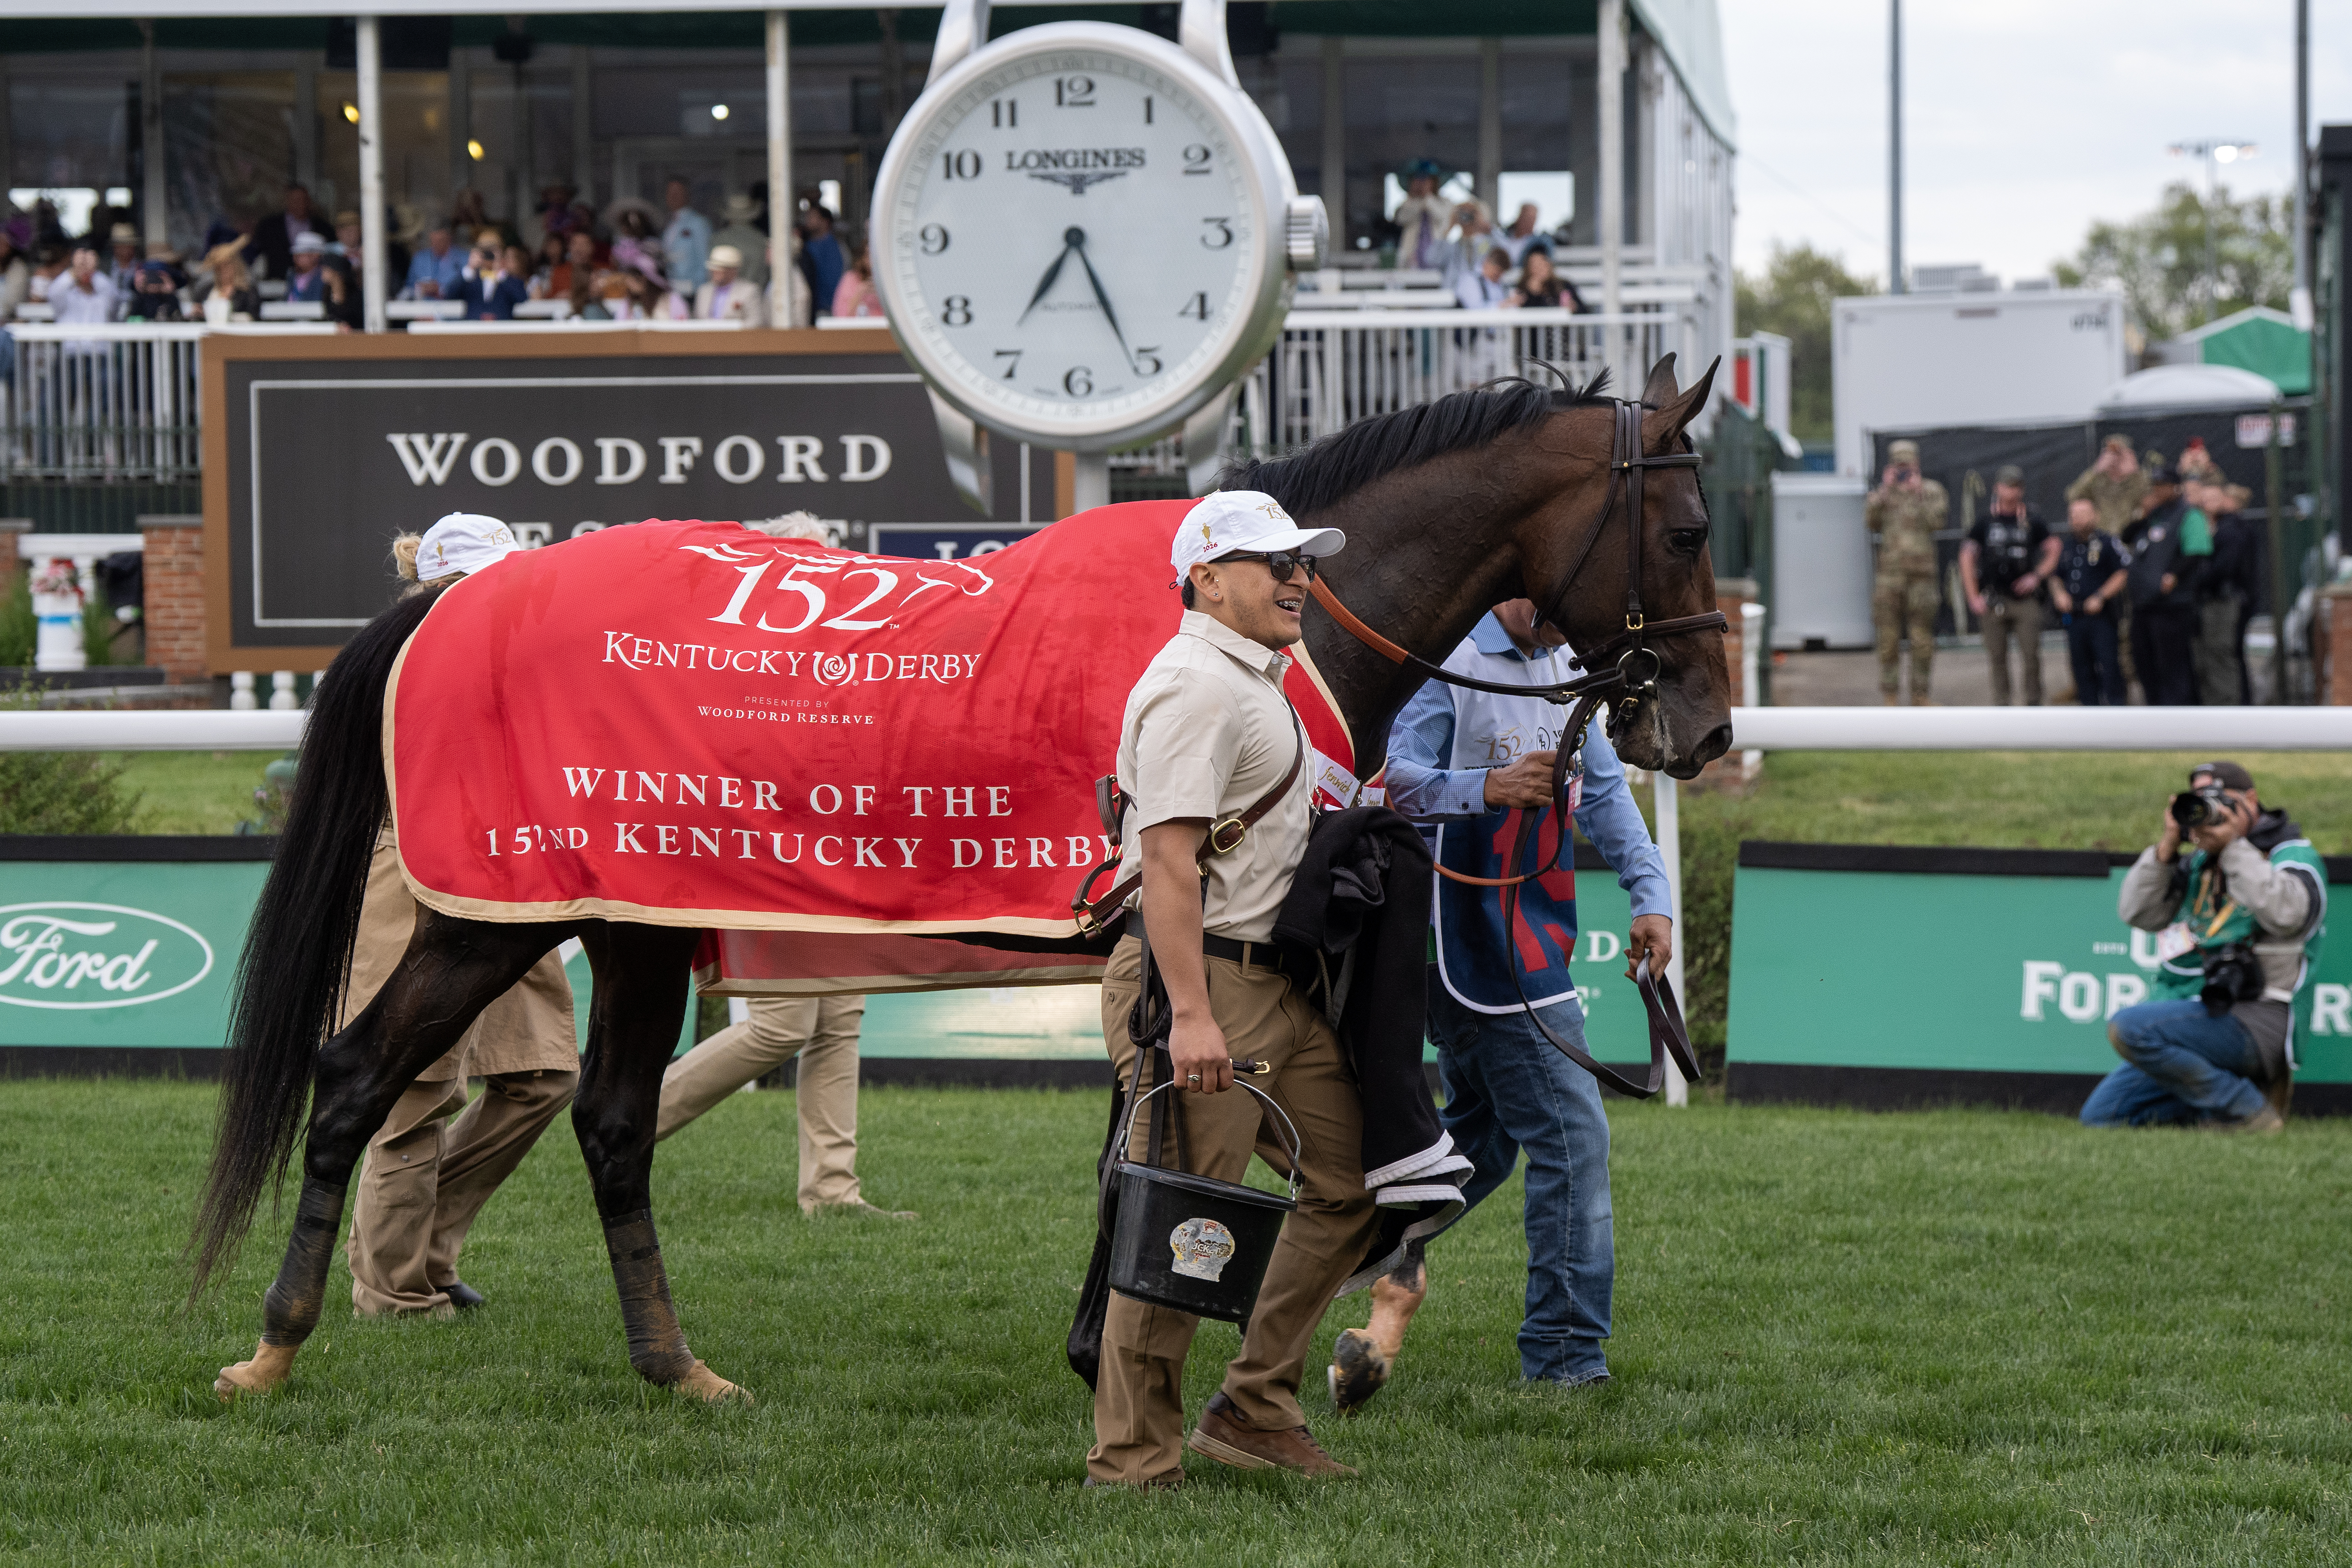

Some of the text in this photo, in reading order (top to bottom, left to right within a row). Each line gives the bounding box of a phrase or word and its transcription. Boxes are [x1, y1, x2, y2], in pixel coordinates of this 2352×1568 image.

[1054, 77, 1096, 108] 12
[990, 98, 1018, 129] 11
[1143, 95, 1155, 125] 1
[943, 150, 982, 181] 10
[1006, 148, 1147, 171] LONGINES
[1181, 144, 1212, 176] 2
[919, 222, 950, 256] 9
[1200, 217, 1234, 250] 3
[940, 295, 975, 327] 8
[1178, 291, 1214, 323] 4
[993, 348, 1023, 380] 7
[1134, 346, 1164, 377] 5
[1063, 366, 1094, 398] 6
[386, 433, 892, 486] WOODFORD
[1203, 542, 1218, 552] 2026
[707, 559, 893, 634] 152
[602, 630, 982, 685] KENTUCKY DERBY
[697, 705, 874, 725] WOODFORD RESERVE
[744, 696, 830, 708] PRESENTED BY
[1485, 735, 1522, 761] 152
[562, 766, 1013, 818] WINNER OF THE
[613, 822, 923, 868] KENTUCKY
[0, 915, 159, 992] Ford
